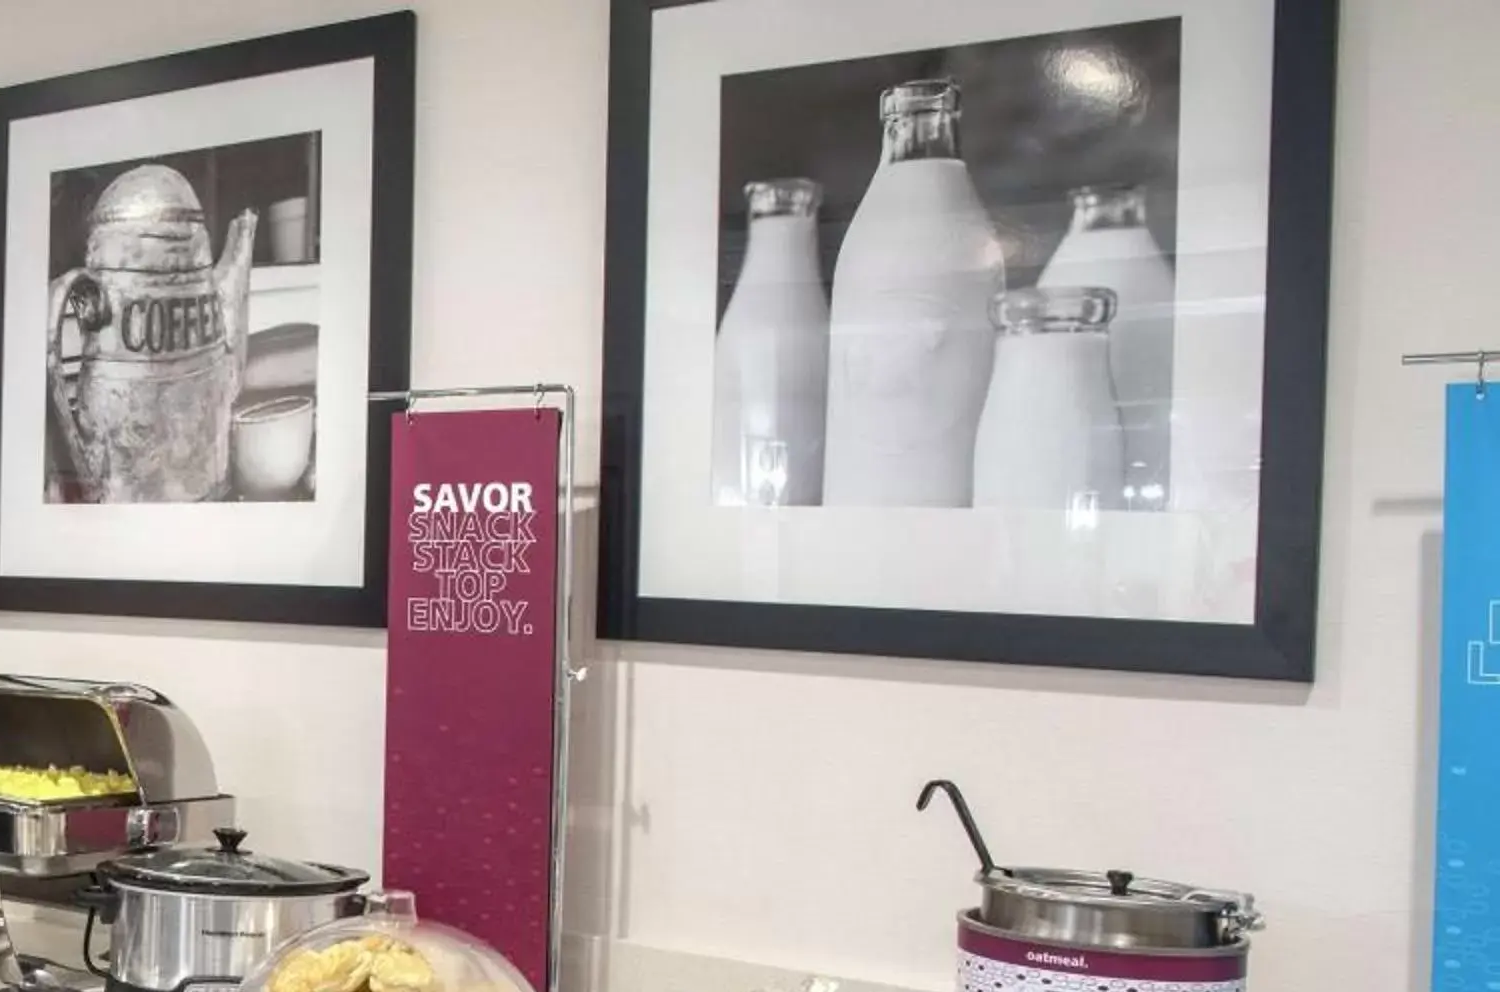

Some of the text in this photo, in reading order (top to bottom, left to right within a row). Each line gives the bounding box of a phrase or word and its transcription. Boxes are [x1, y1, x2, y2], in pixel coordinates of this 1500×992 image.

[413, 482, 534, 513] SAVOR
[408, 511, 537, 543] SNACK
[412, 541, 531, 573] STACK
[435, 570, 507, 602] TOP
[406, 597, 534, 634] ENJOY.
[1026, 950, 1089, 969] oatmeal.
